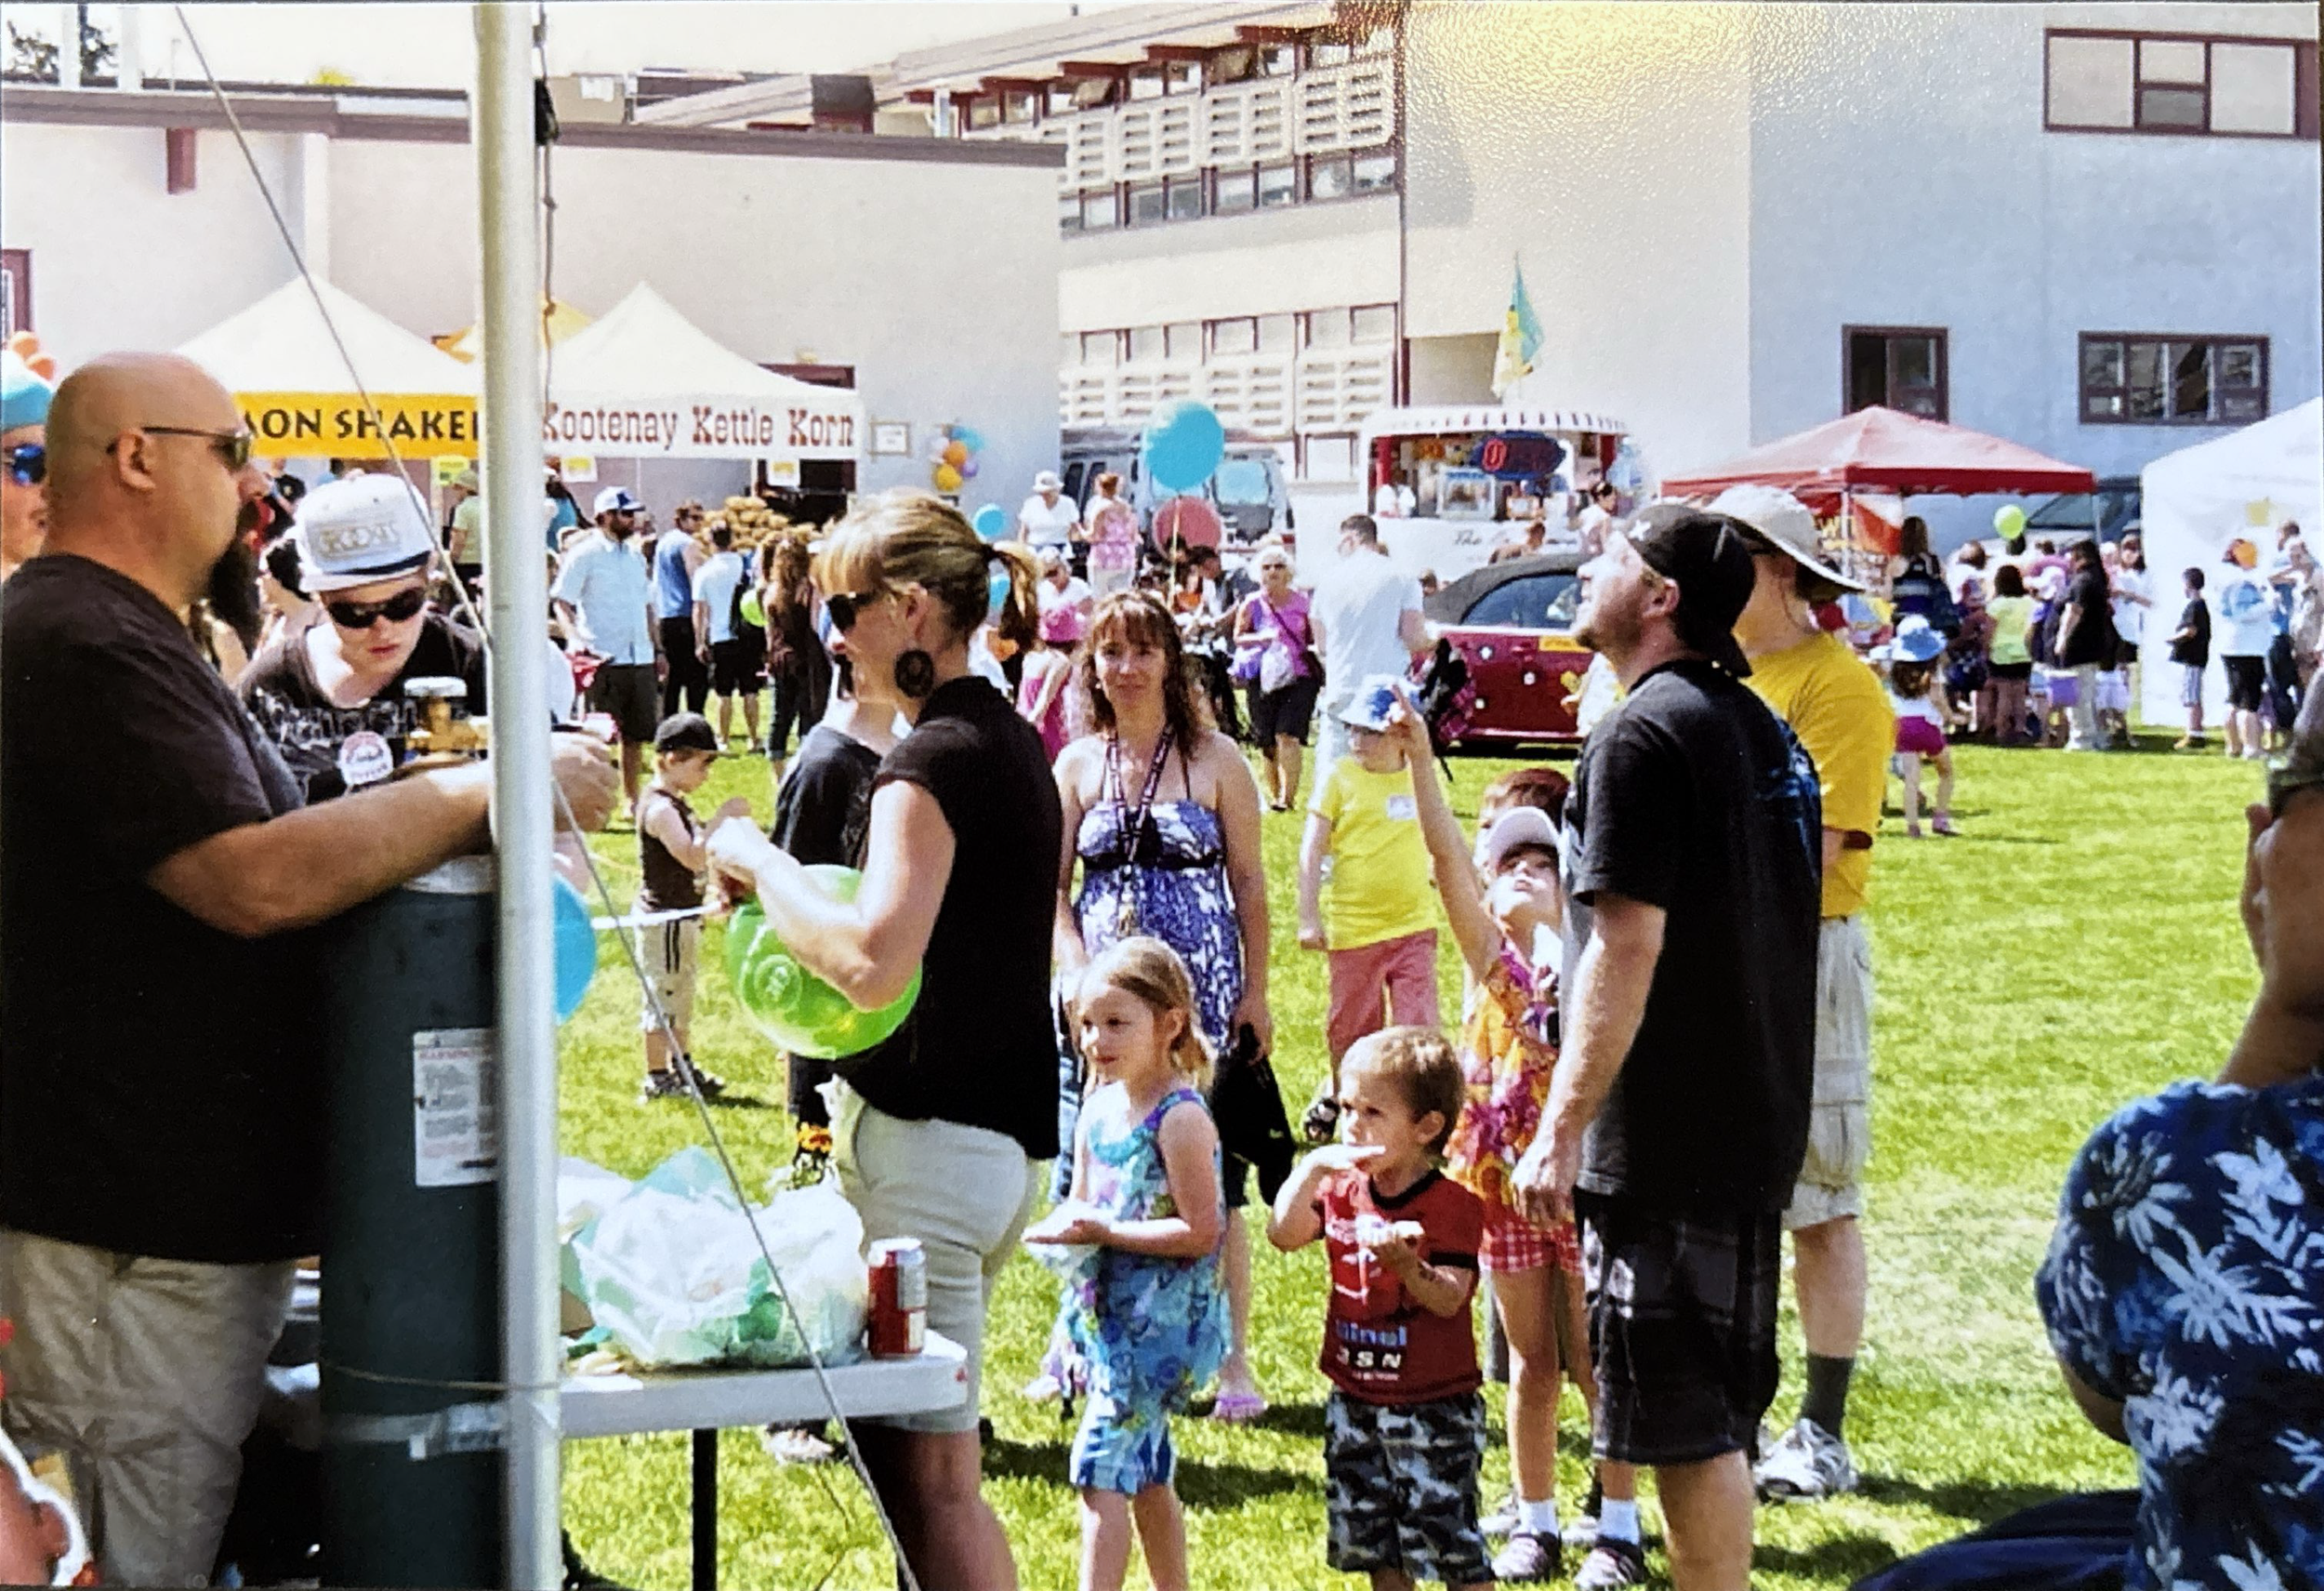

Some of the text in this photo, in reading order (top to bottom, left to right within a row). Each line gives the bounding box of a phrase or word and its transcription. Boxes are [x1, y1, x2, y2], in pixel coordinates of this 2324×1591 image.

[542, 403, 853, 451] Kootenay Kettle Korn
